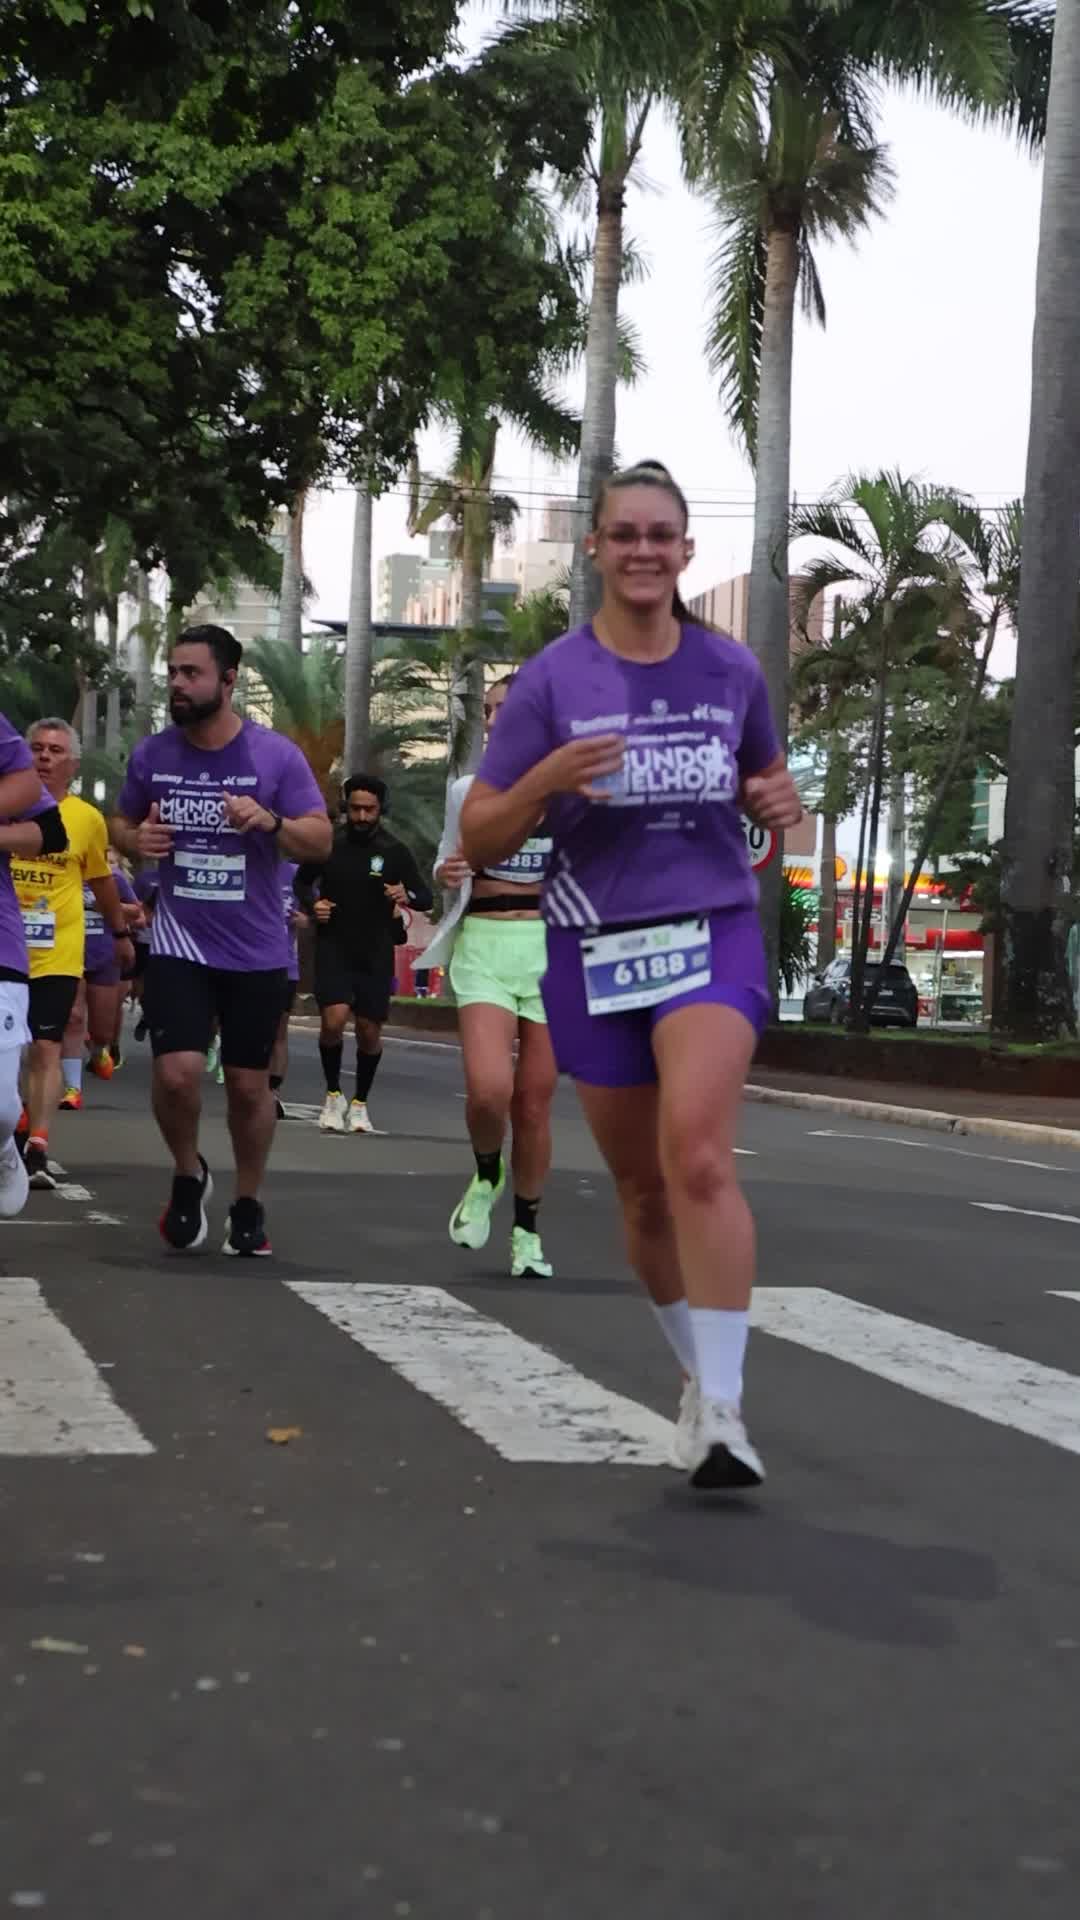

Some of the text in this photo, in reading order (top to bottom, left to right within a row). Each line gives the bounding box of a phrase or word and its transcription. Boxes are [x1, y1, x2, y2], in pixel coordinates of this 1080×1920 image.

[622, 745, 714, 771] UNDO
[623, 764, 728, 793] ELHOR
[160, 810, 231, 826] MELHO
[499, 853, 543, 867] 383
[186, 869, 229, 885] 5639
[613, 952, 686, 986] 6188
